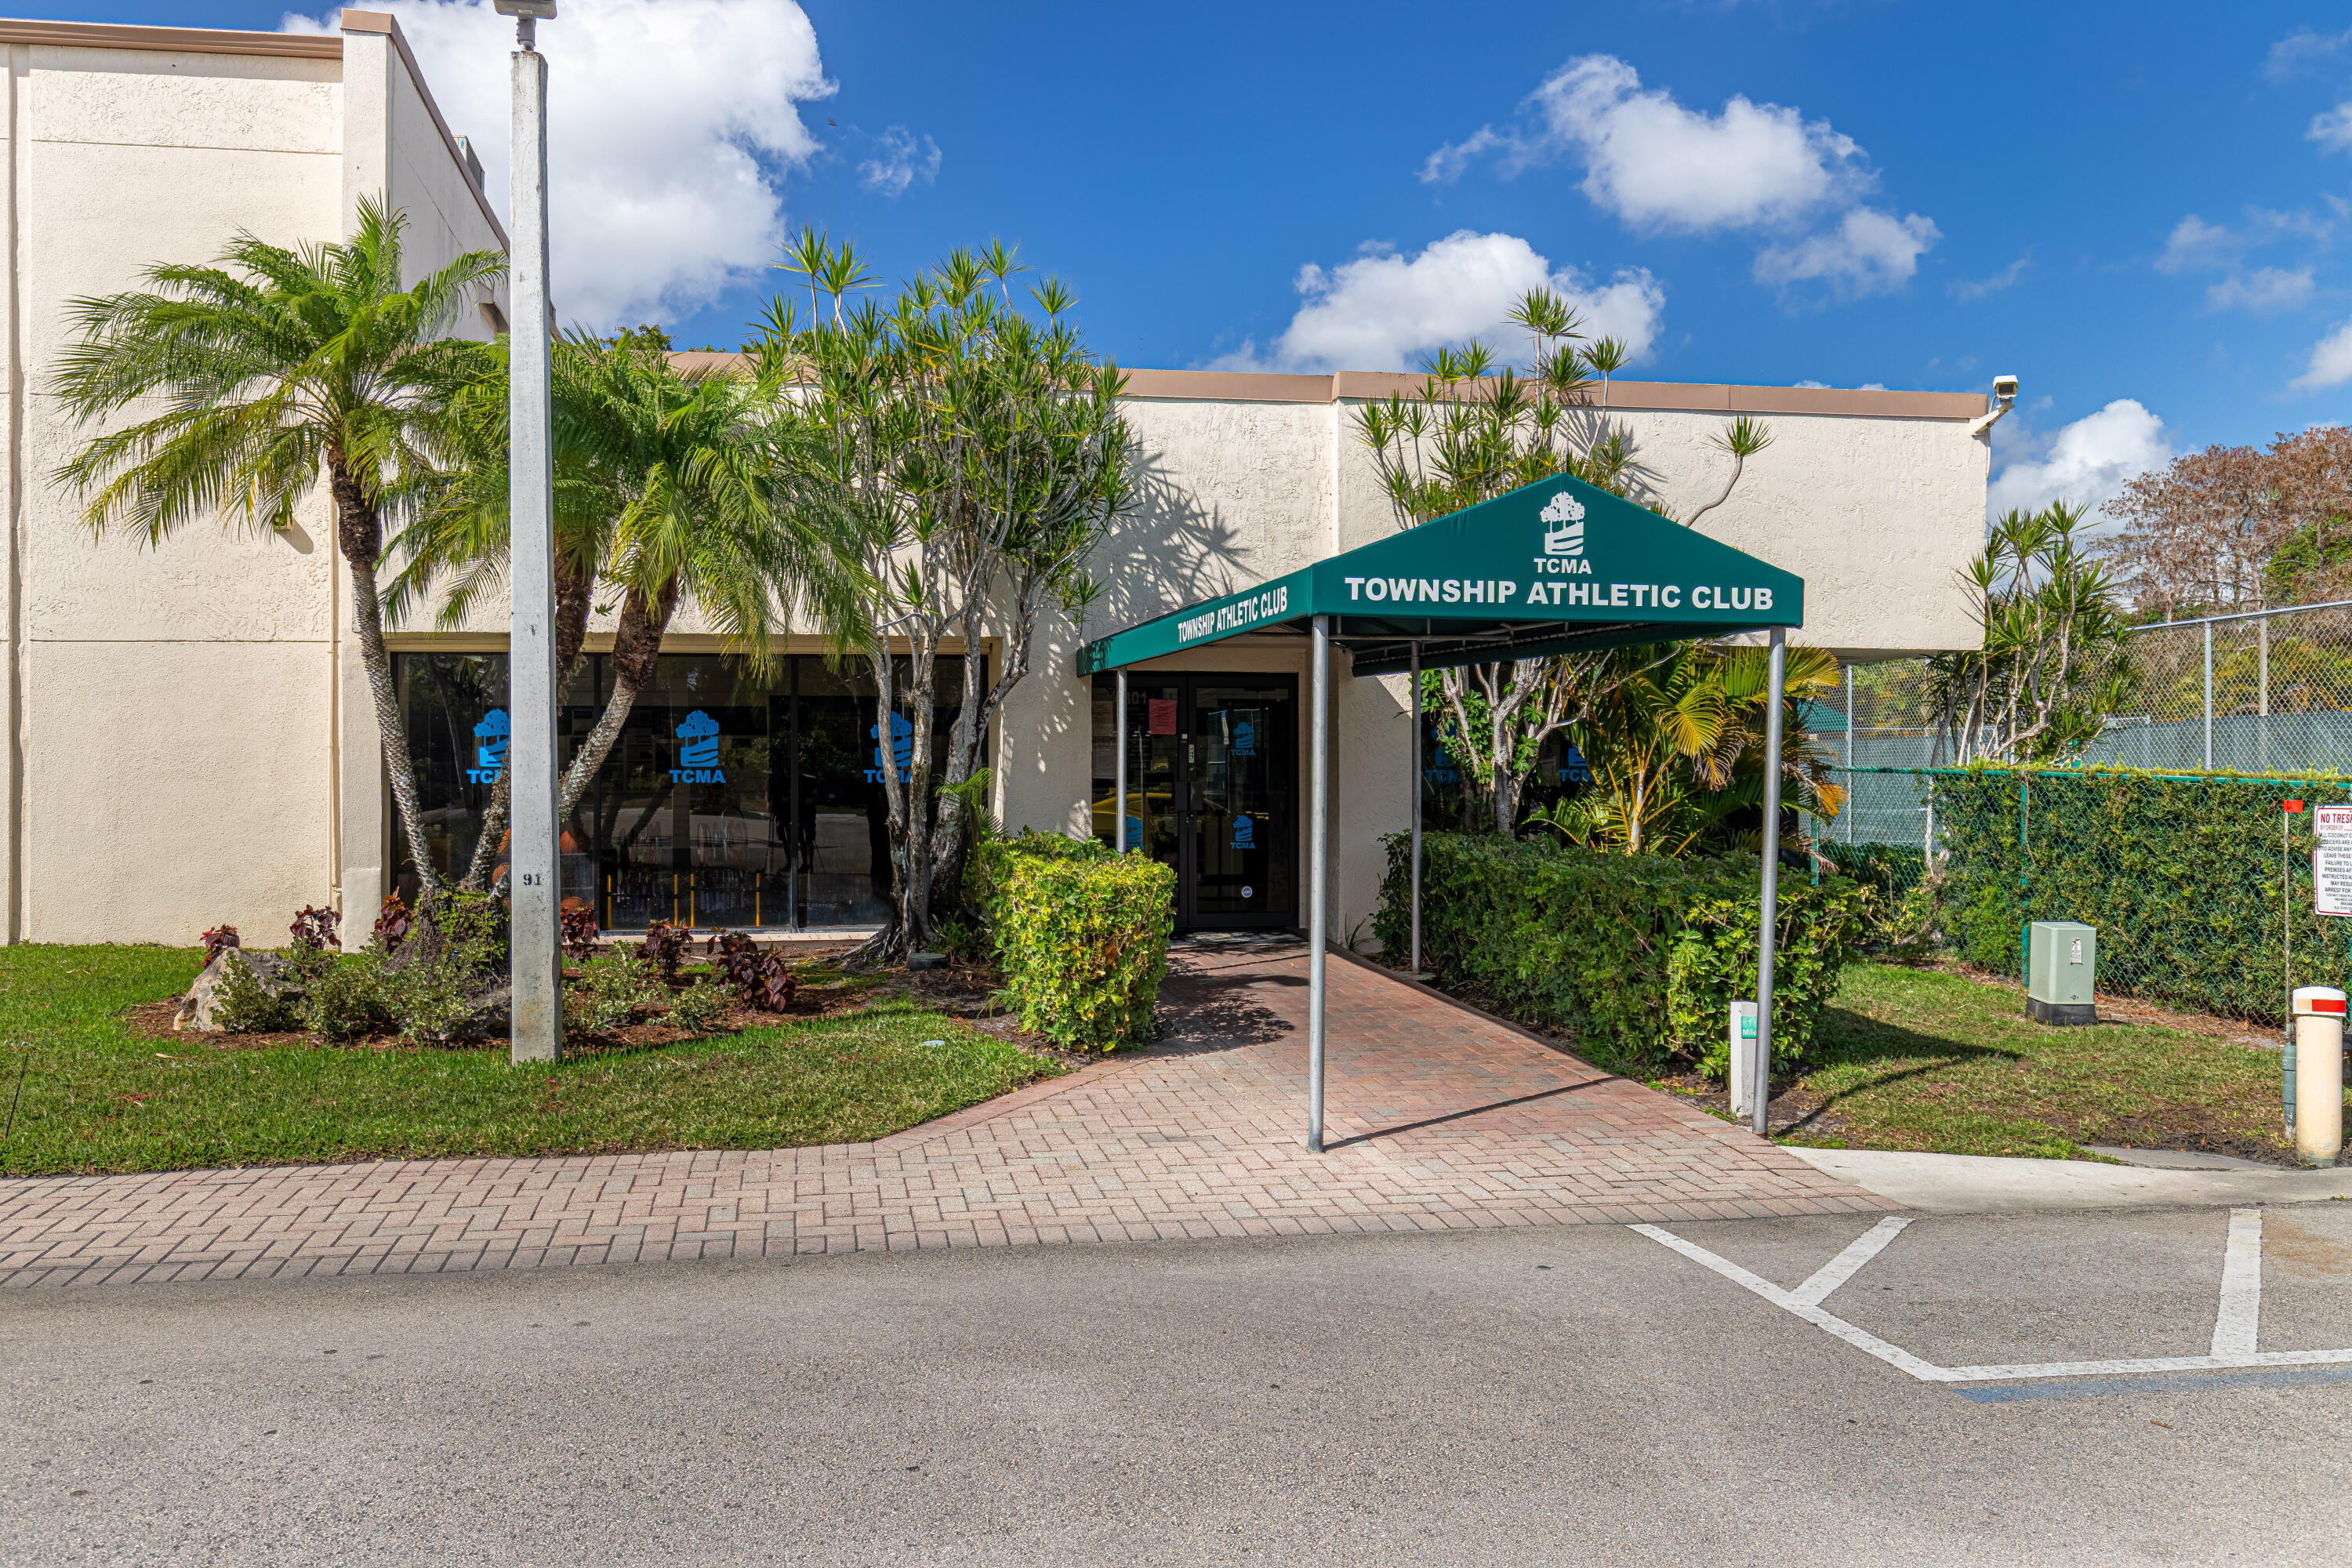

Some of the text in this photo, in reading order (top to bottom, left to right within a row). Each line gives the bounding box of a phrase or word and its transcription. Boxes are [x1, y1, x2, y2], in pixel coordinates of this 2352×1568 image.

[1534, 557, 1592, 575] TCMA
[1344, 576, 1773, 610] TOWNSHIP ATHLETIC CLUB
[1178, 586, 1287, 644] TOWNSHIP ATHLETIC CLUB
[466, 769, 502, 784] TC
[669, 769, 726, 784] TCMA
[1425, 769, 1462, 782] TCM
[1559, 769, 1595, 782] TCM
[2321, 813, 2330, 823] NO
[523, 873, 542, 886] 91
